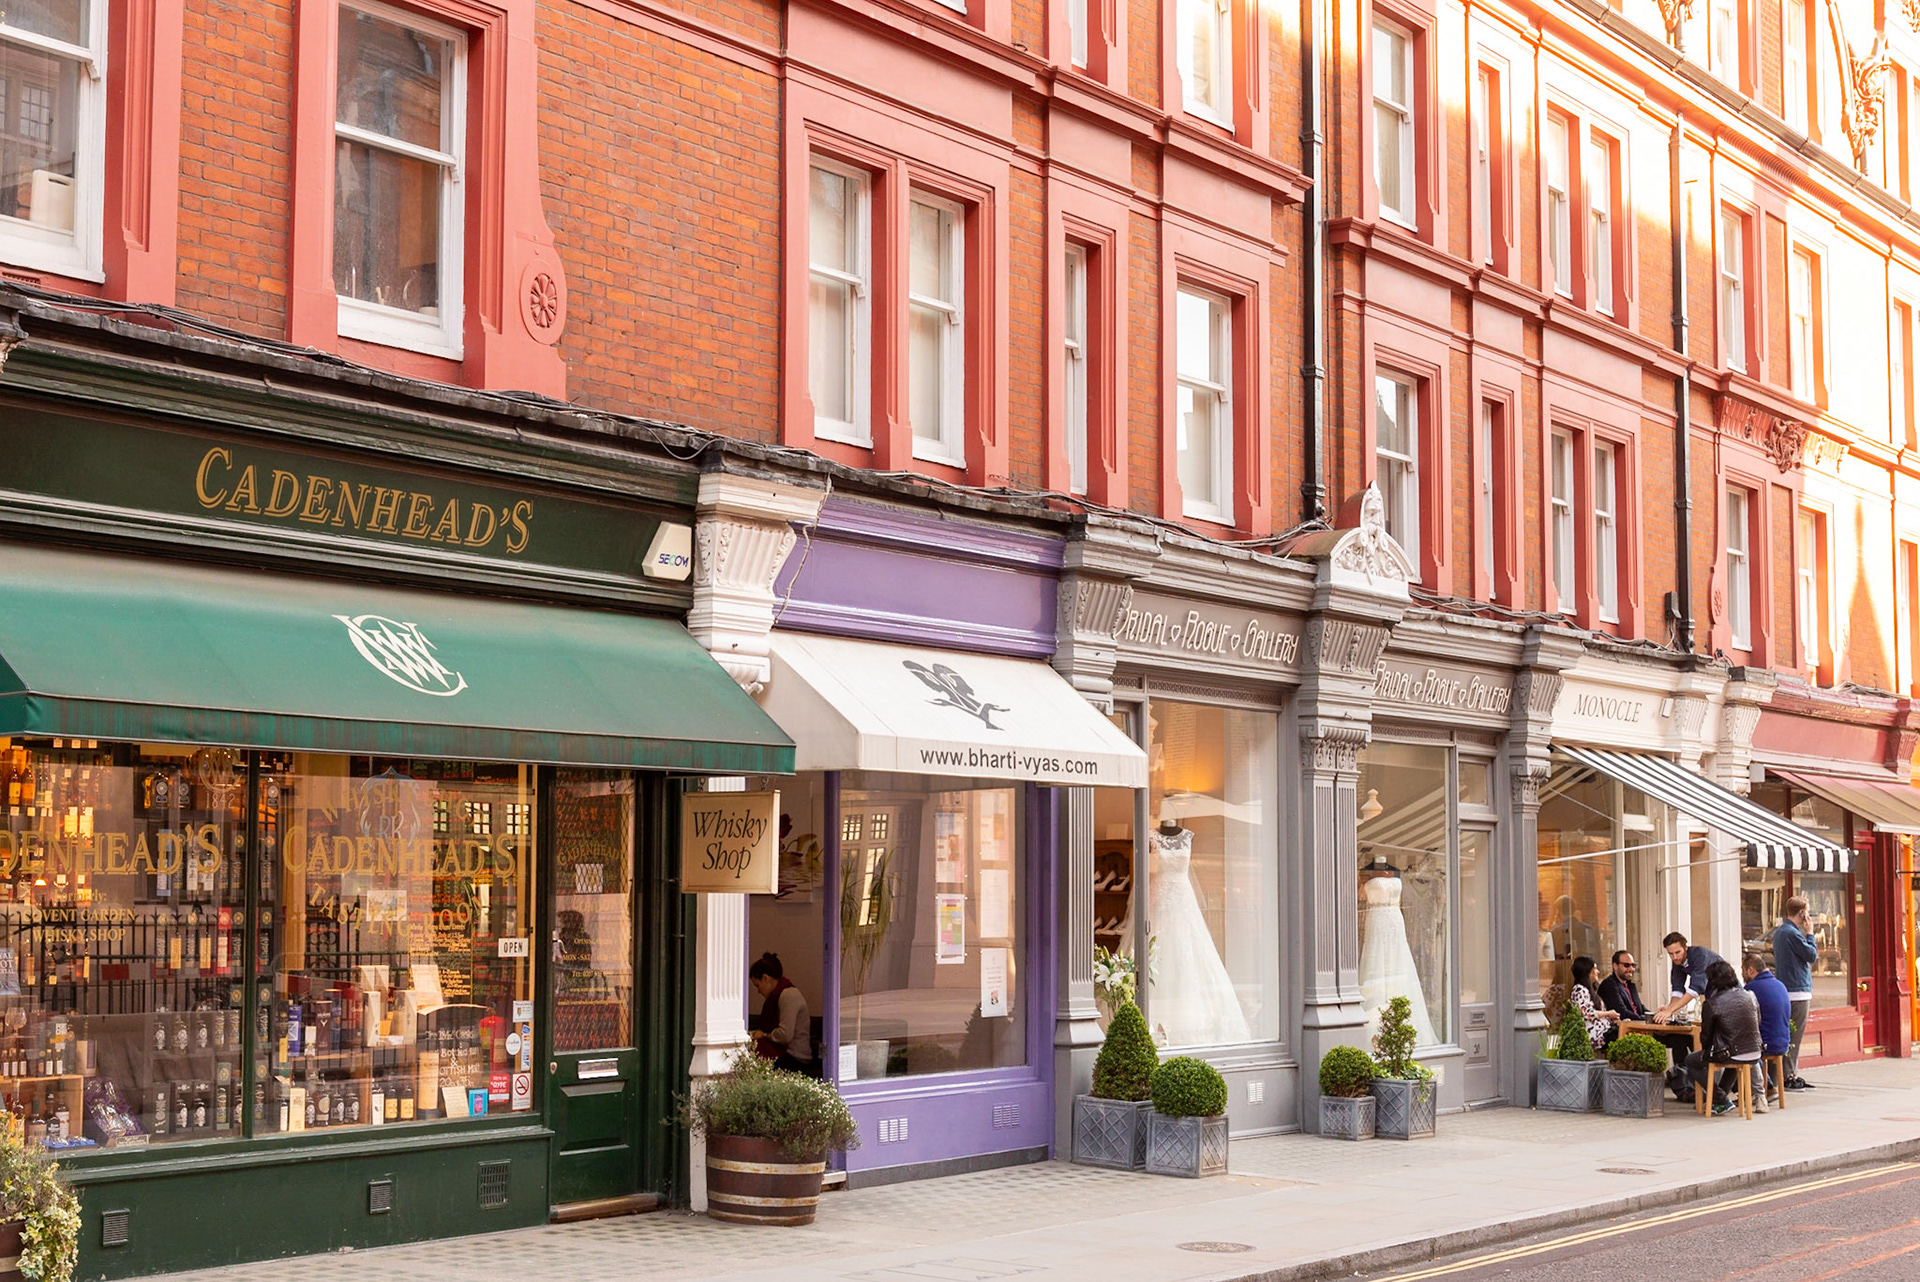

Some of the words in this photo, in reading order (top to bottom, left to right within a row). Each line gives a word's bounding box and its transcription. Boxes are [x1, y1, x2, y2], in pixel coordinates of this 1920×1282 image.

[196, 447, 533, 554] CADENHEAD'S
[659, 553, 689, 568] SECOM
[1181, 610, 1231, 654] ROGUE
[1243, 619, 1300, 665] GALLERY
[1421, 669, 1461, 707] ROGUE
[1466, 675, 1512, 714] GALLERY
[1573, 694, 1643, 722] MONOCLE
[920, 747, 1098, 775] www.bharti-vyas.com
[205, 792, 235, 809] 1842
[693, 809, 767, 848] Whisky
[283, 825, 518, 877] CADENHEAD'S
[703, 842, 751, 878] Shop
[23, 908, 77, 922] COVENT
[81, 908, 137, 922] GARDEN
[33, 928, 87, 944] WHISKY
[90, 928, 126, 942] SHOP
[503, 941, 524, 954] OPEN
